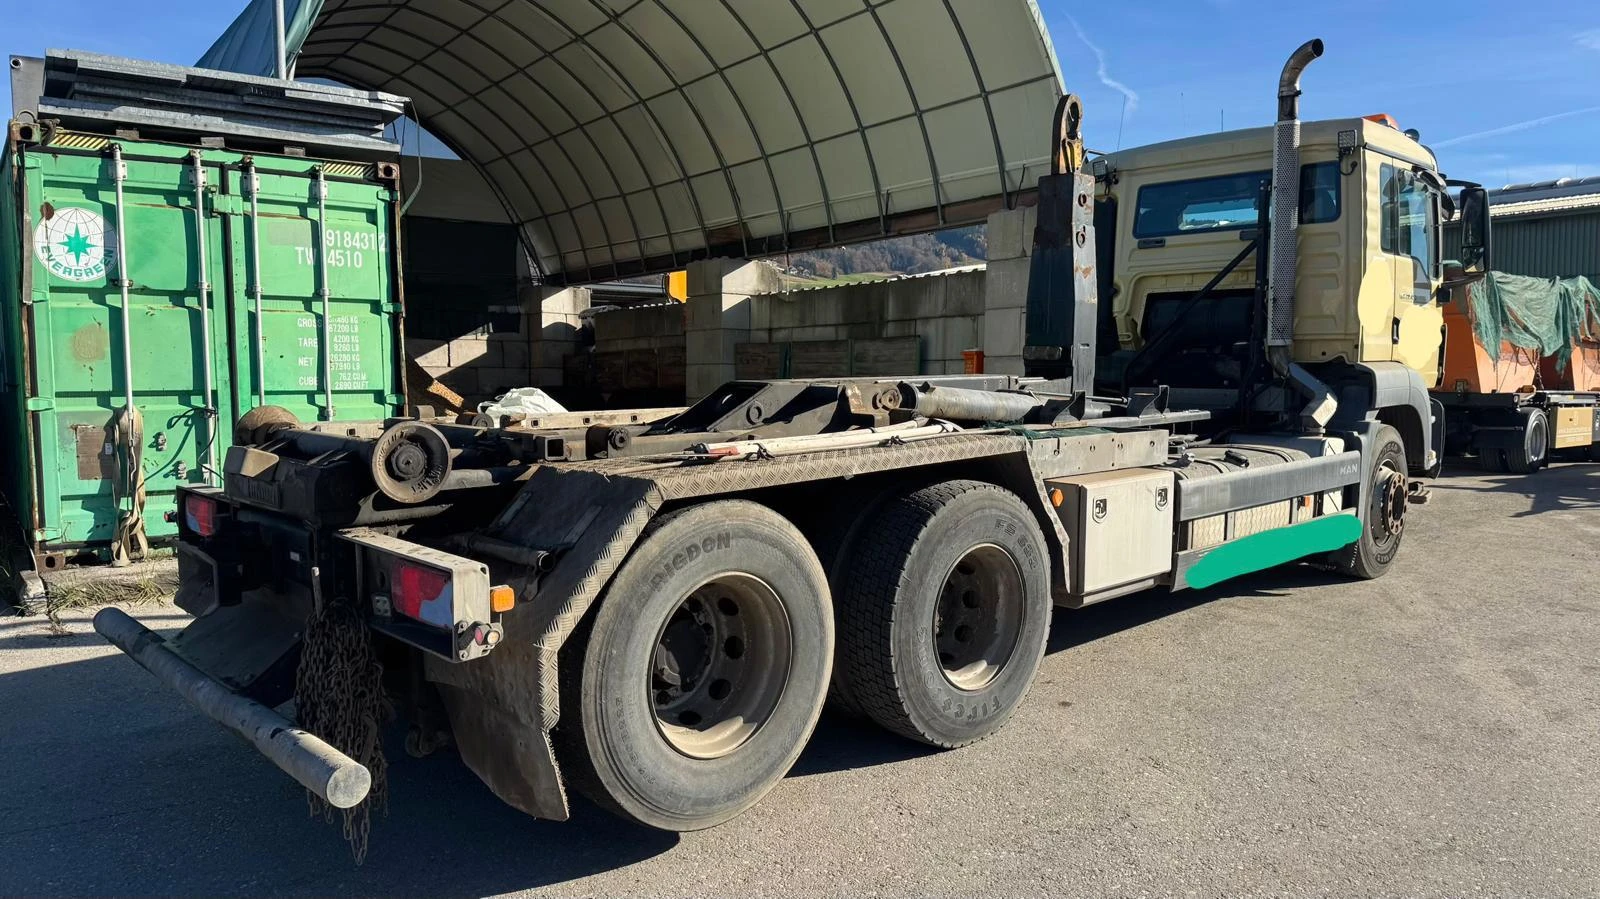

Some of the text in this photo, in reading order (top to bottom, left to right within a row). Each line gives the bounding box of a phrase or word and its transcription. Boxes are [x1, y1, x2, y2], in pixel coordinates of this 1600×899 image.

[41, 246, 114, 277] EVERGREEN
[327, 249, 363, 268] 4510
[298, 337, 318, 348] TARE
[298, 357, 314, 367] NET
[298, 376, 319, 386] CUBE
[1340, 463, 1358, 475] MAN
[649, 531, 731, 592] RIGDON
